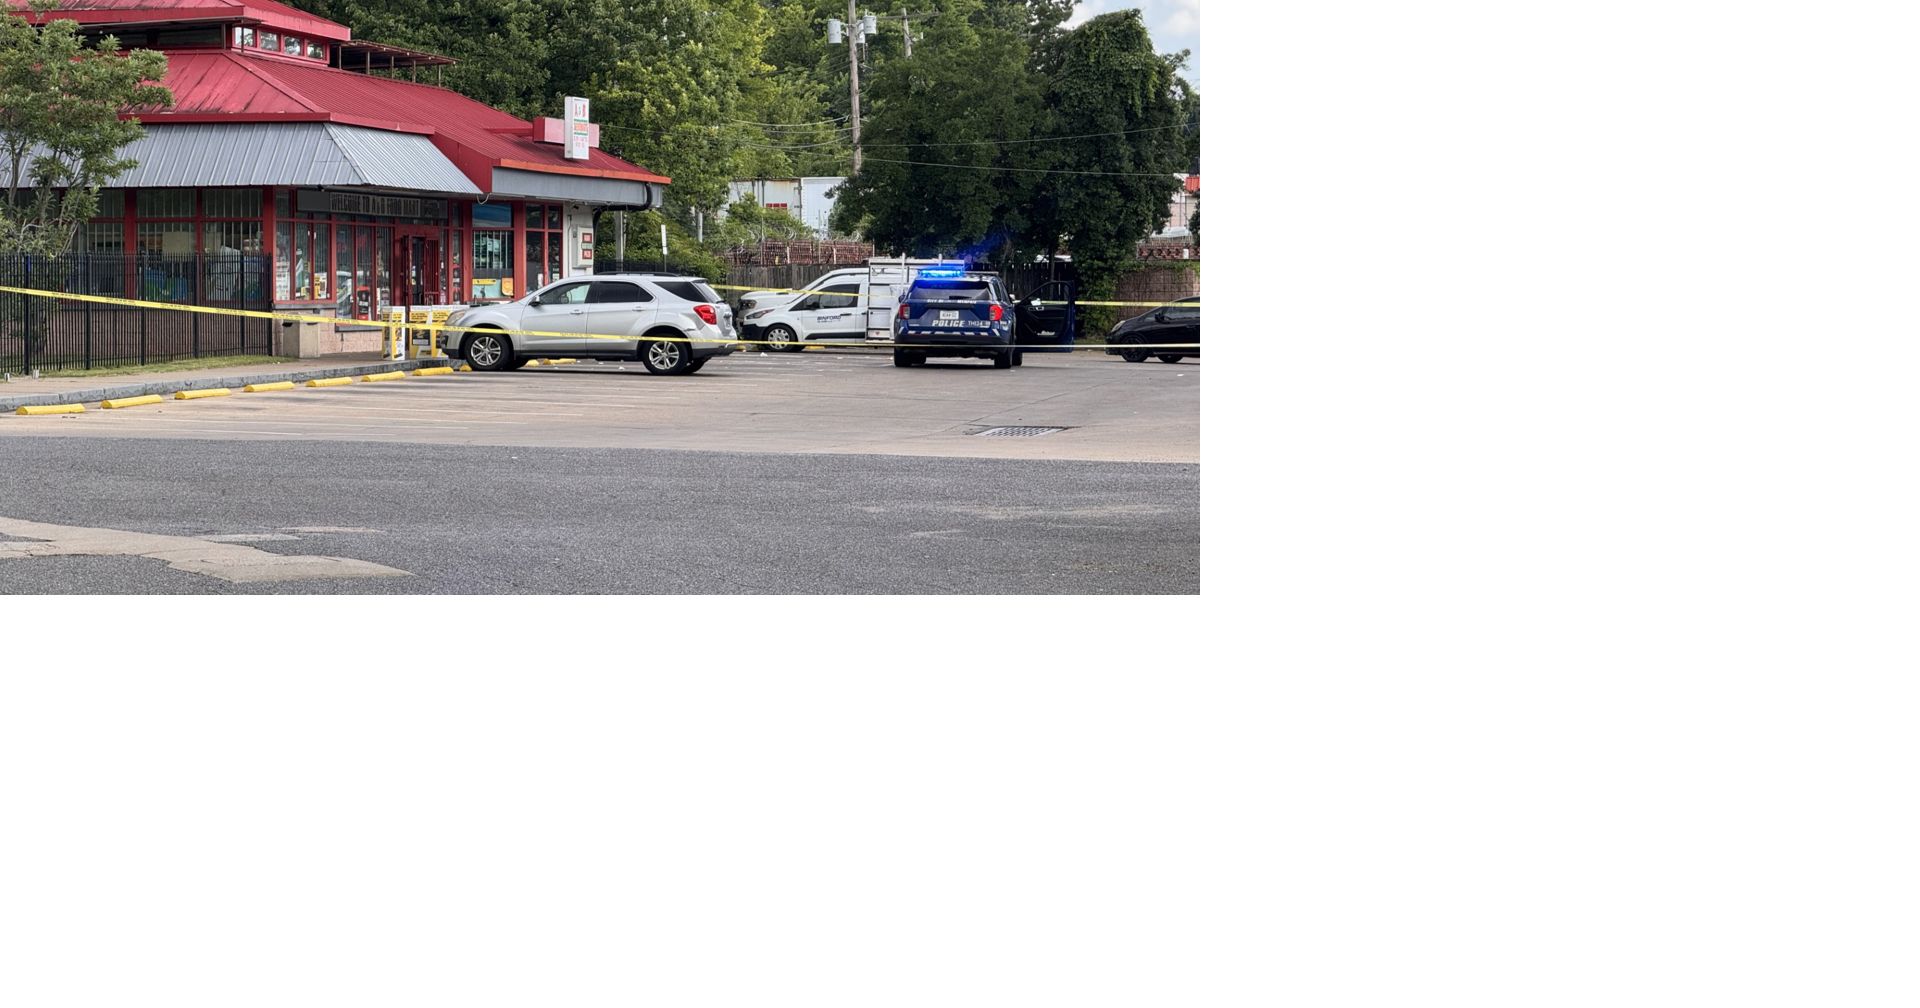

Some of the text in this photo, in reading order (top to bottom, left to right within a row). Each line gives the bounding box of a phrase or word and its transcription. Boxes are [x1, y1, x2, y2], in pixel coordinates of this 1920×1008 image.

[582, 104, 587, 117] B
[331, 193, 361, 212] WELCOME
[362, 195, 370, 212] TO
[380, 197, 386, 214] B
[387, 198, 402, 215] FOOD
[403, 199, 419, 216] MART
[932, 319, 965, 327] POLICE
